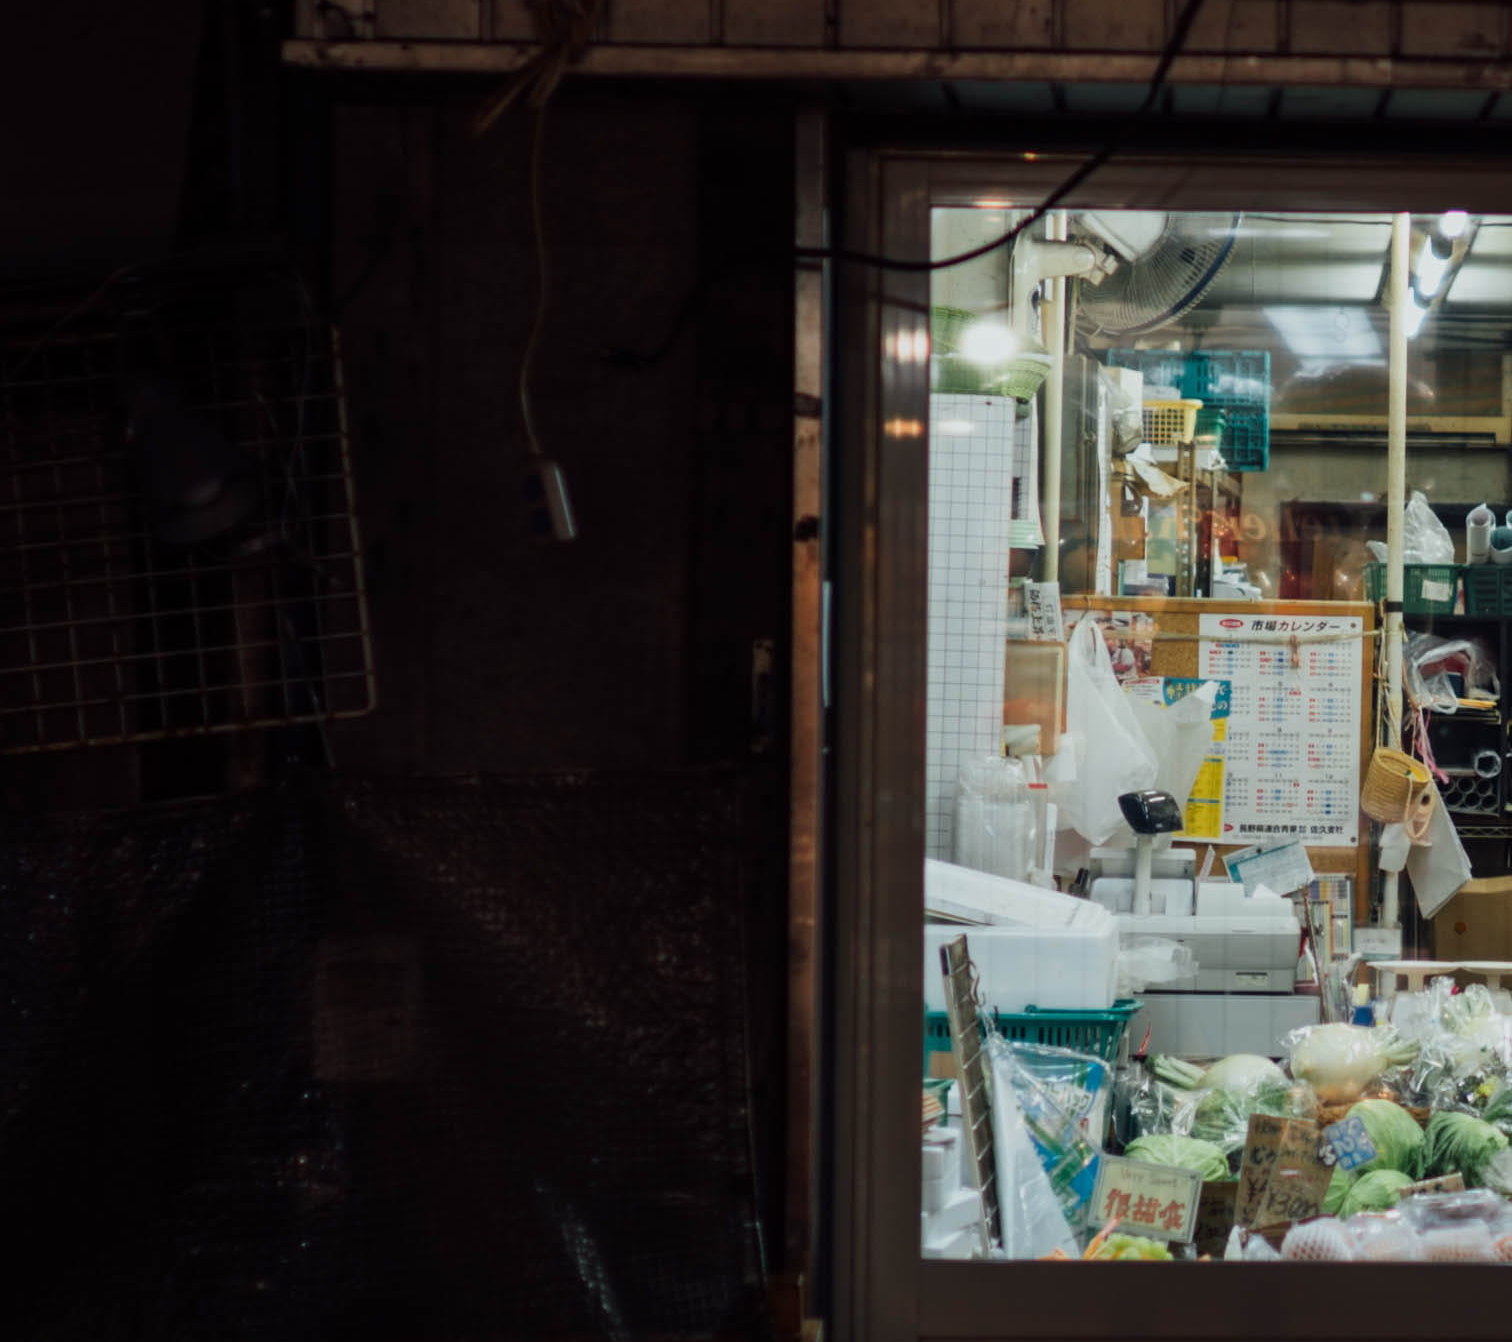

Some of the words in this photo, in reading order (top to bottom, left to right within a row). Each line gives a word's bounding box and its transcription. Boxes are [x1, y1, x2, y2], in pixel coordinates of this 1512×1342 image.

[1251, 619, 1341, 632] 市場カレンダー
